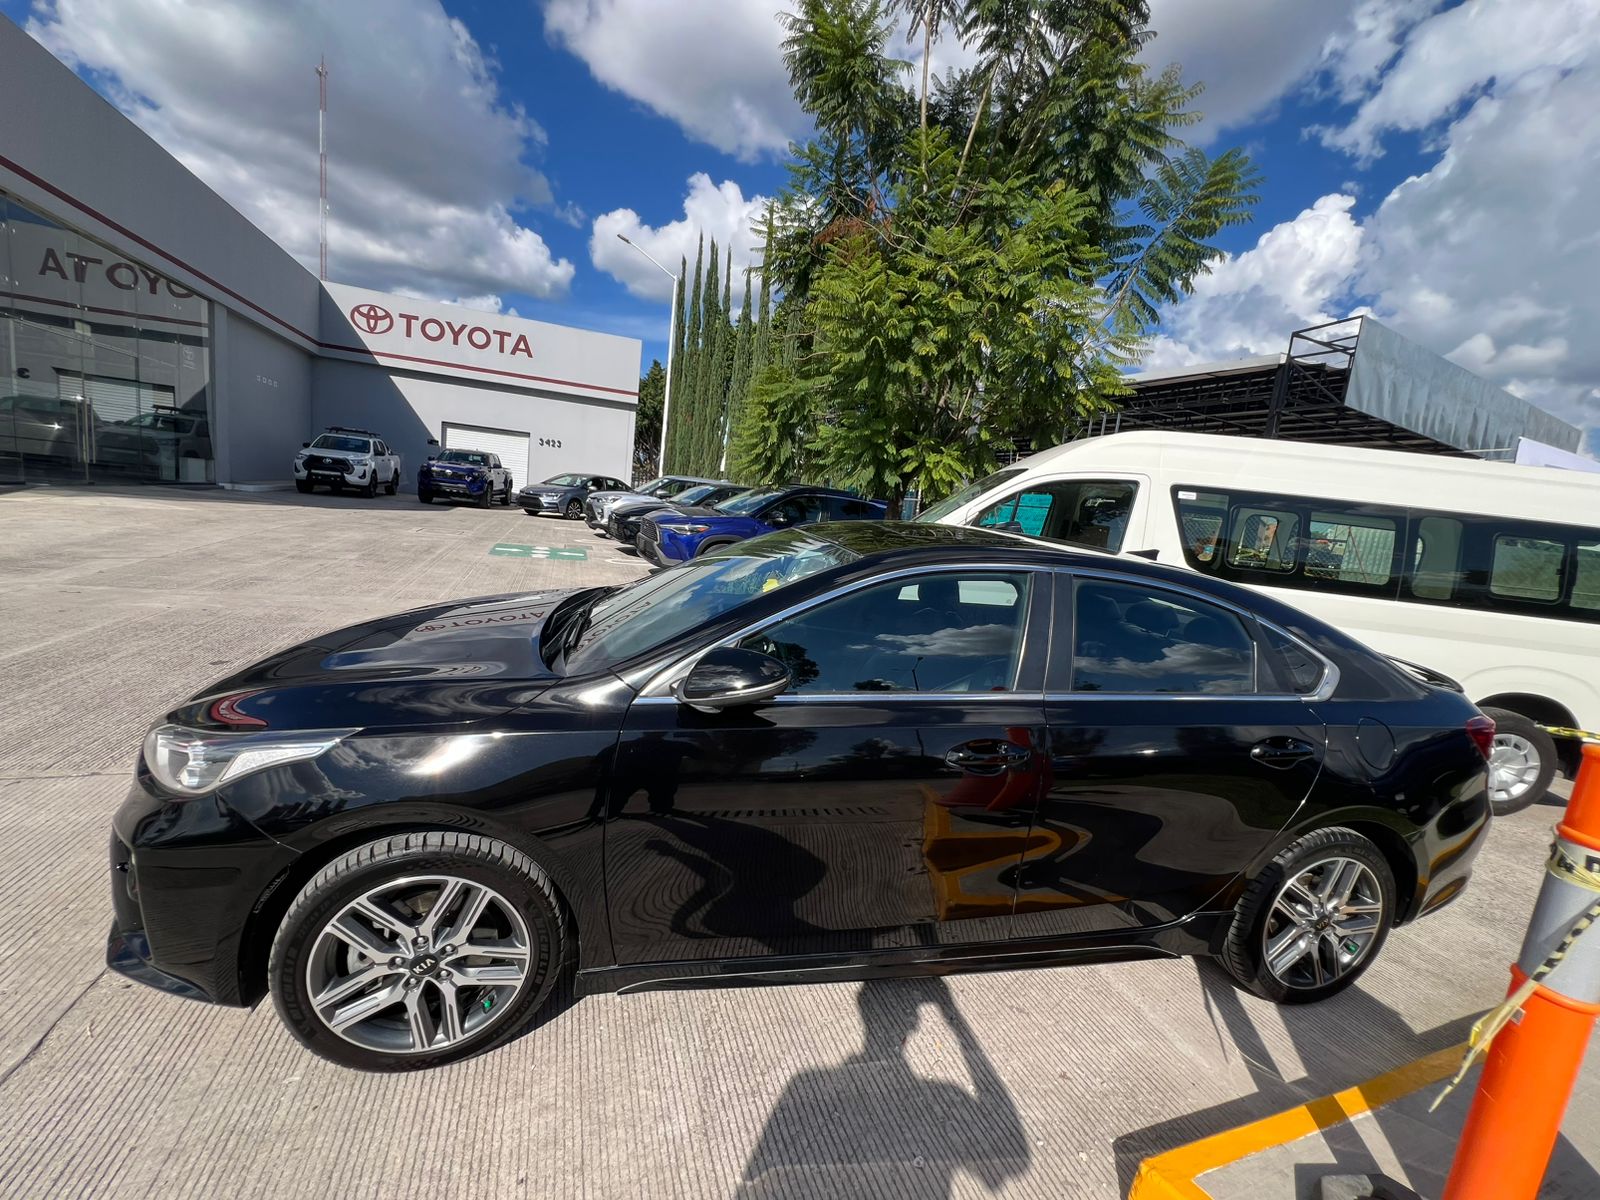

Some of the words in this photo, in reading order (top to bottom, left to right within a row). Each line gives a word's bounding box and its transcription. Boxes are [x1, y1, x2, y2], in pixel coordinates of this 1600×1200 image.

[398, 312, 534, 359] TOYOTA
[538, 437, 562, 449] 3423
[412, 957, 436, 974] KIA
